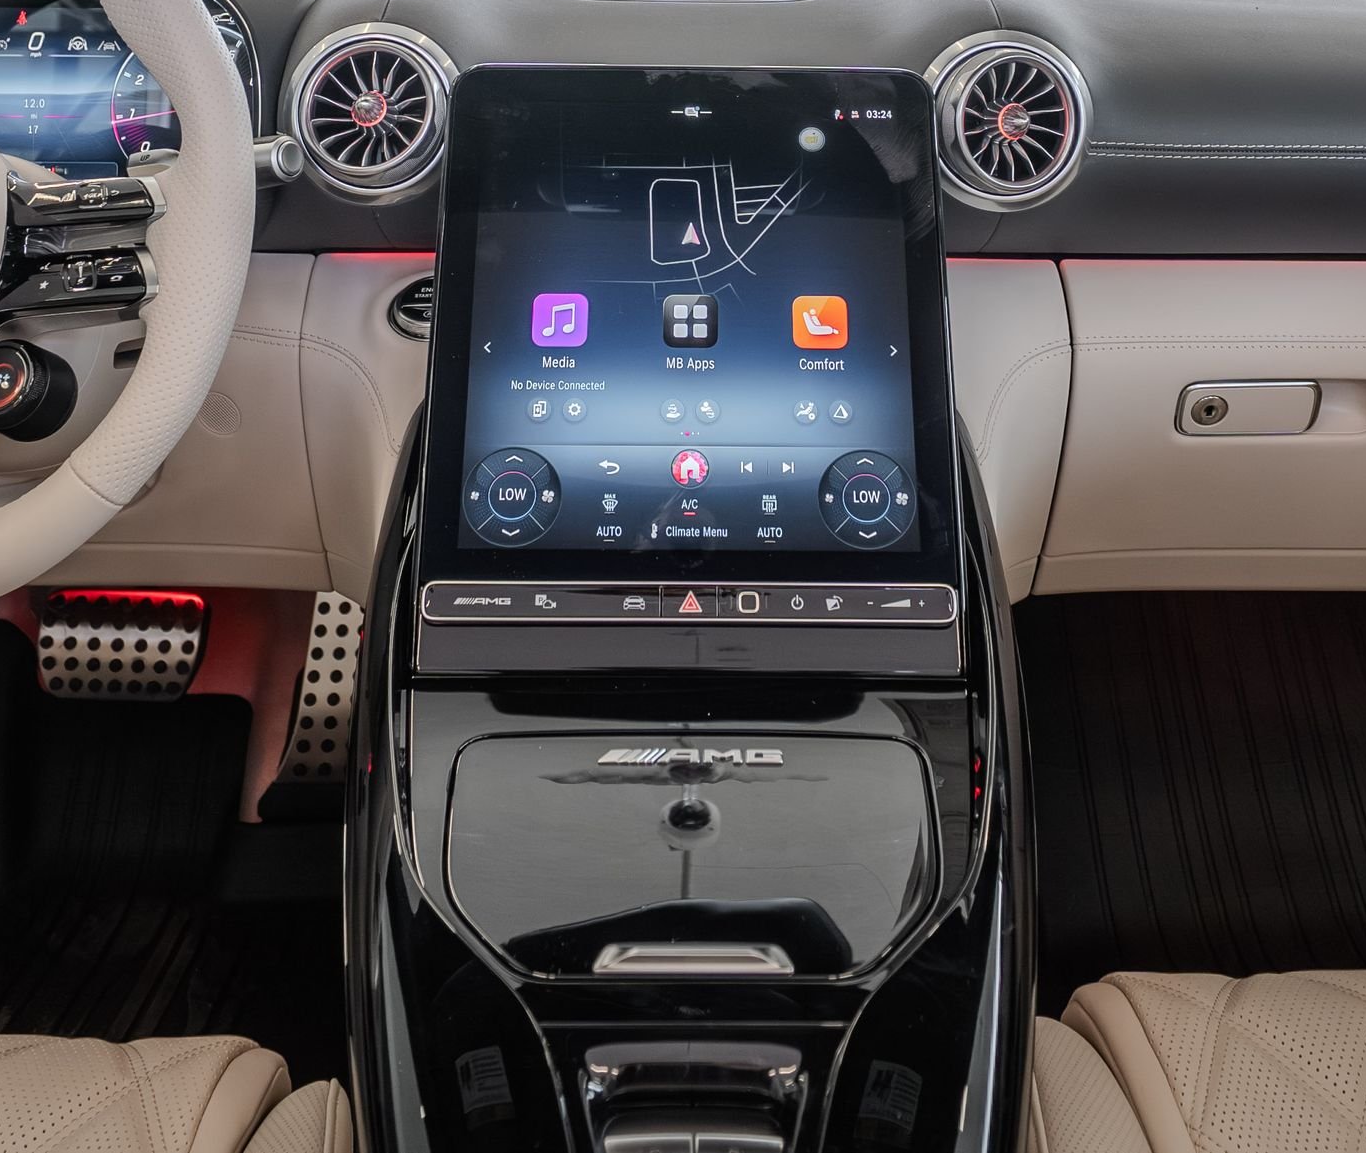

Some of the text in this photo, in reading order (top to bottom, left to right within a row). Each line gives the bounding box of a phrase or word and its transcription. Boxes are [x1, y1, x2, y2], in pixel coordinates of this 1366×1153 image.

[27, 31, 45, 51] 0
[134, 74, 145, 86] 2
[23, 98, 45, 108] 12.0
[128, 107, 137, 120] 1
[866, 109, 892, 119] 03:24
[27, 124, 39, 134] 17
[140, 140, 151, 152] 0
[139, 153, 151, 161] UP
[541, 355, 845, 374] Media MB Apps Comfort
[510, 379, 606, 391] No Device Connected
[497, 487, 527, 503] LOW
[852, 489, 881, 505] LOW
[680, 498, 699, 512] A/C
[596, 525, 783, 539] AUTO Climate Menu AUTO
[473, 596, 512, 607] AMG
[663, 748, 785, 766] AMG
